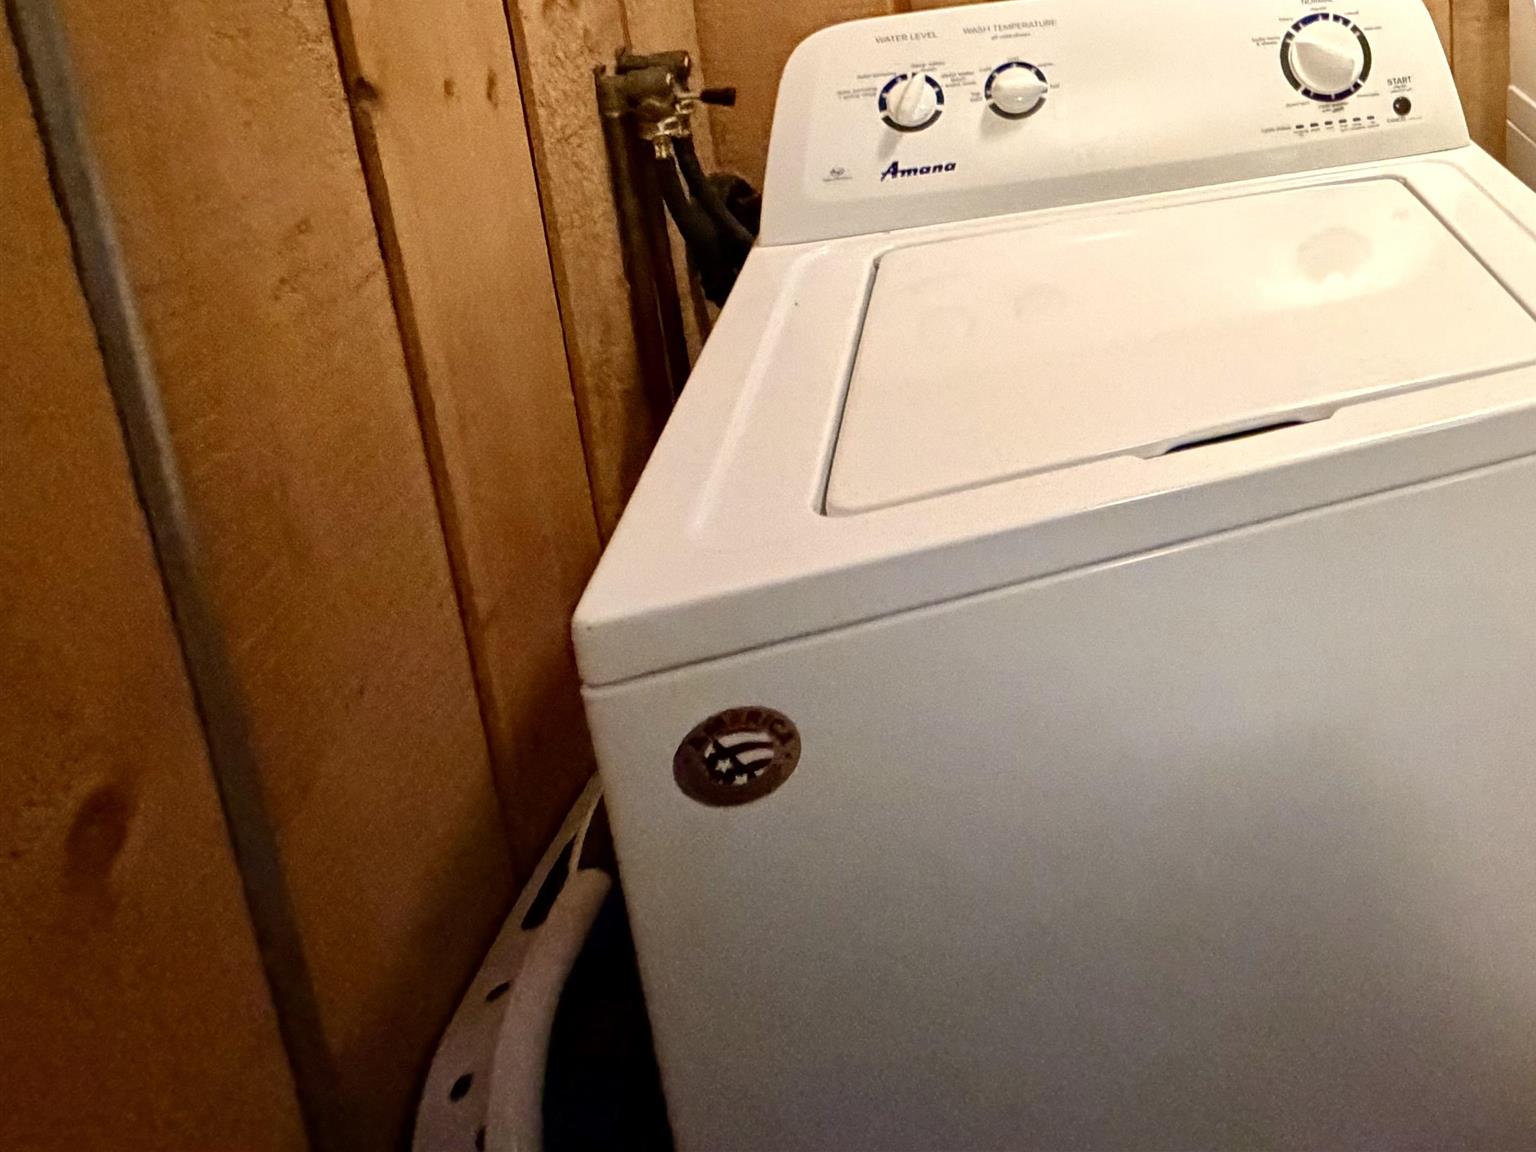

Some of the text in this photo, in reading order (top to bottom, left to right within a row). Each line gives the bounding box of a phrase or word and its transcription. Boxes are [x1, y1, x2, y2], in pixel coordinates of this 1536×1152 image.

[962, 19, 1057, 35] WASH TEMPERATURE
[875, 31, 939, 44] WATER LEVEL
[1386, 75, 1412, 86] START
[880, 160, 957, 182] Amana
